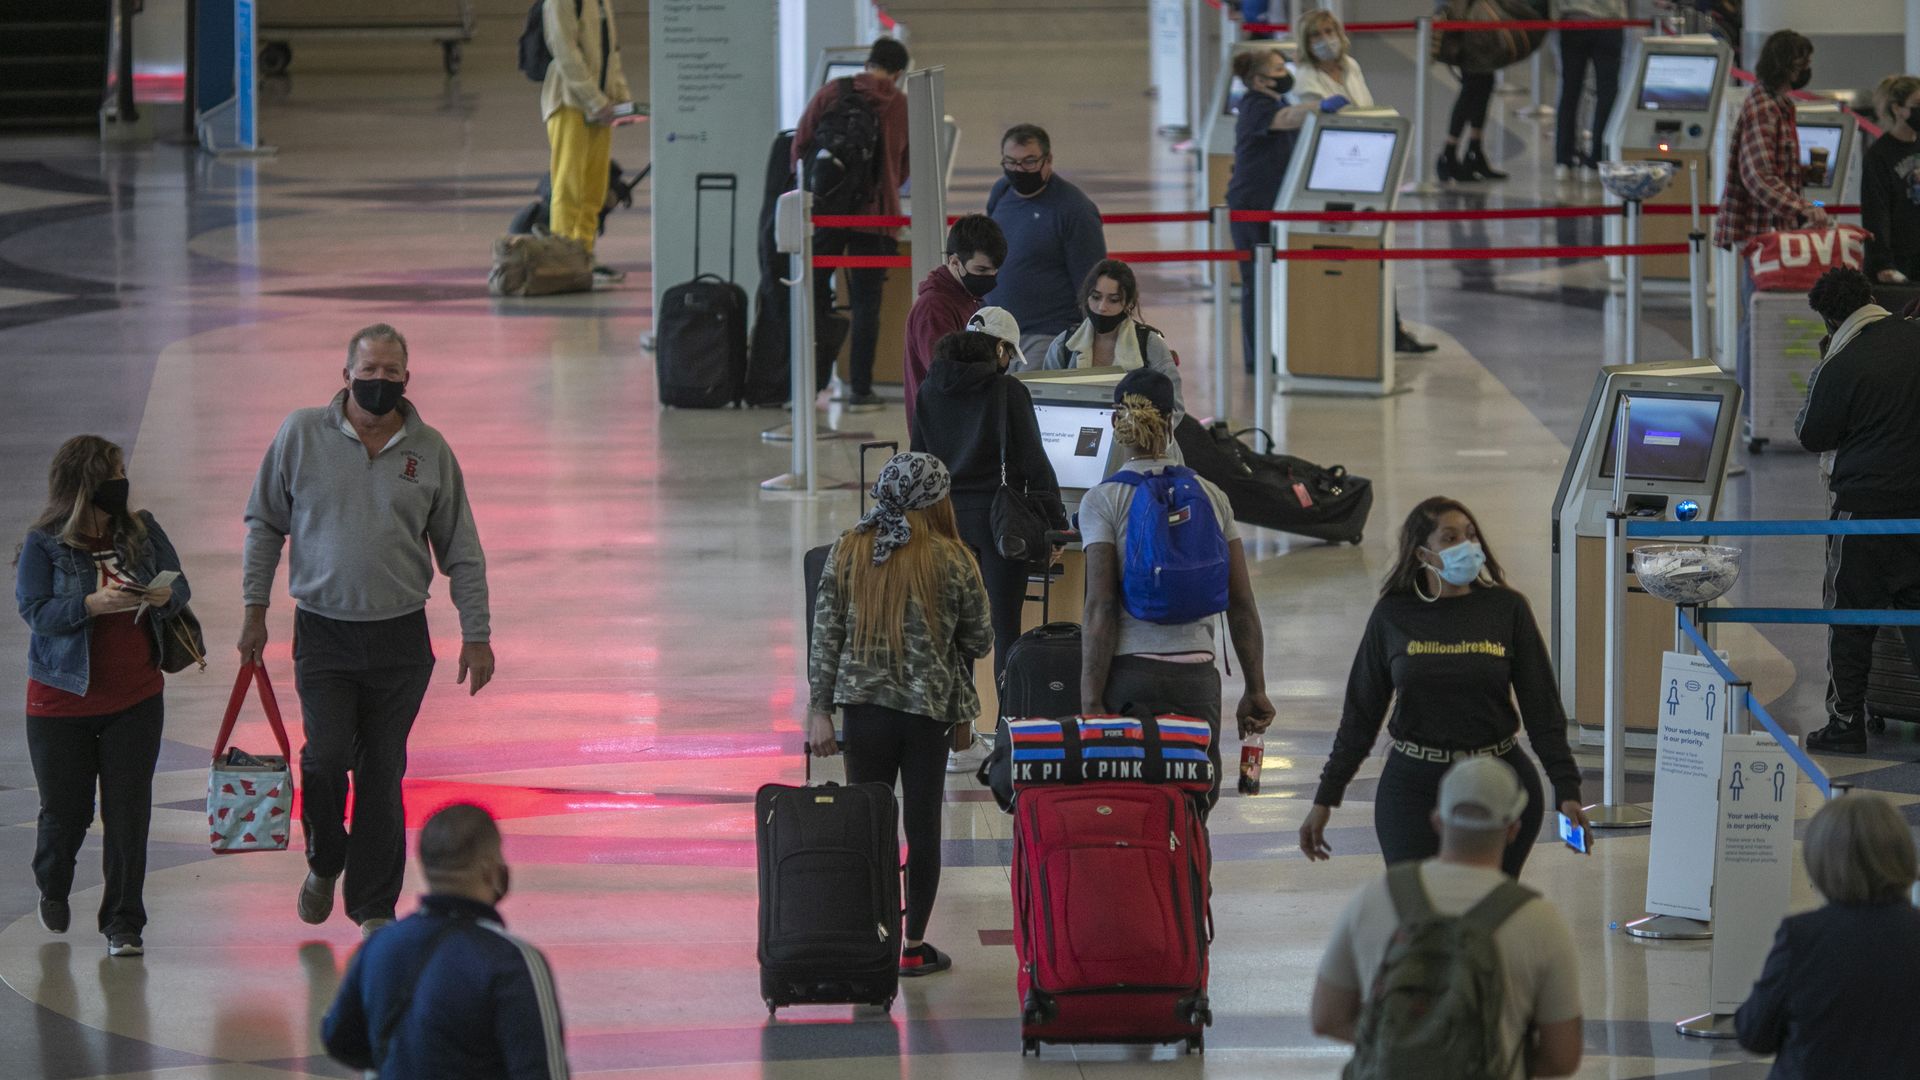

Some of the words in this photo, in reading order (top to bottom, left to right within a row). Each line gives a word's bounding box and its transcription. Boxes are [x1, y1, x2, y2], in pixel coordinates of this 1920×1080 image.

[1751, 228, 1864, 275] LOVE
[1407, 640, 1506, 657] @billionaireshair
[1664, 725, 1678, 733] Your
[1679, 728, 1710, 739] well-being
[1680, 737, 1704, 747] priority.
[1098, 761, 1142, 778] PINK
[1166, 762, 1197, 779] INK
[1744, 813, 1779, 822] well-being
[1746, 823, 1772, 831] priority.
